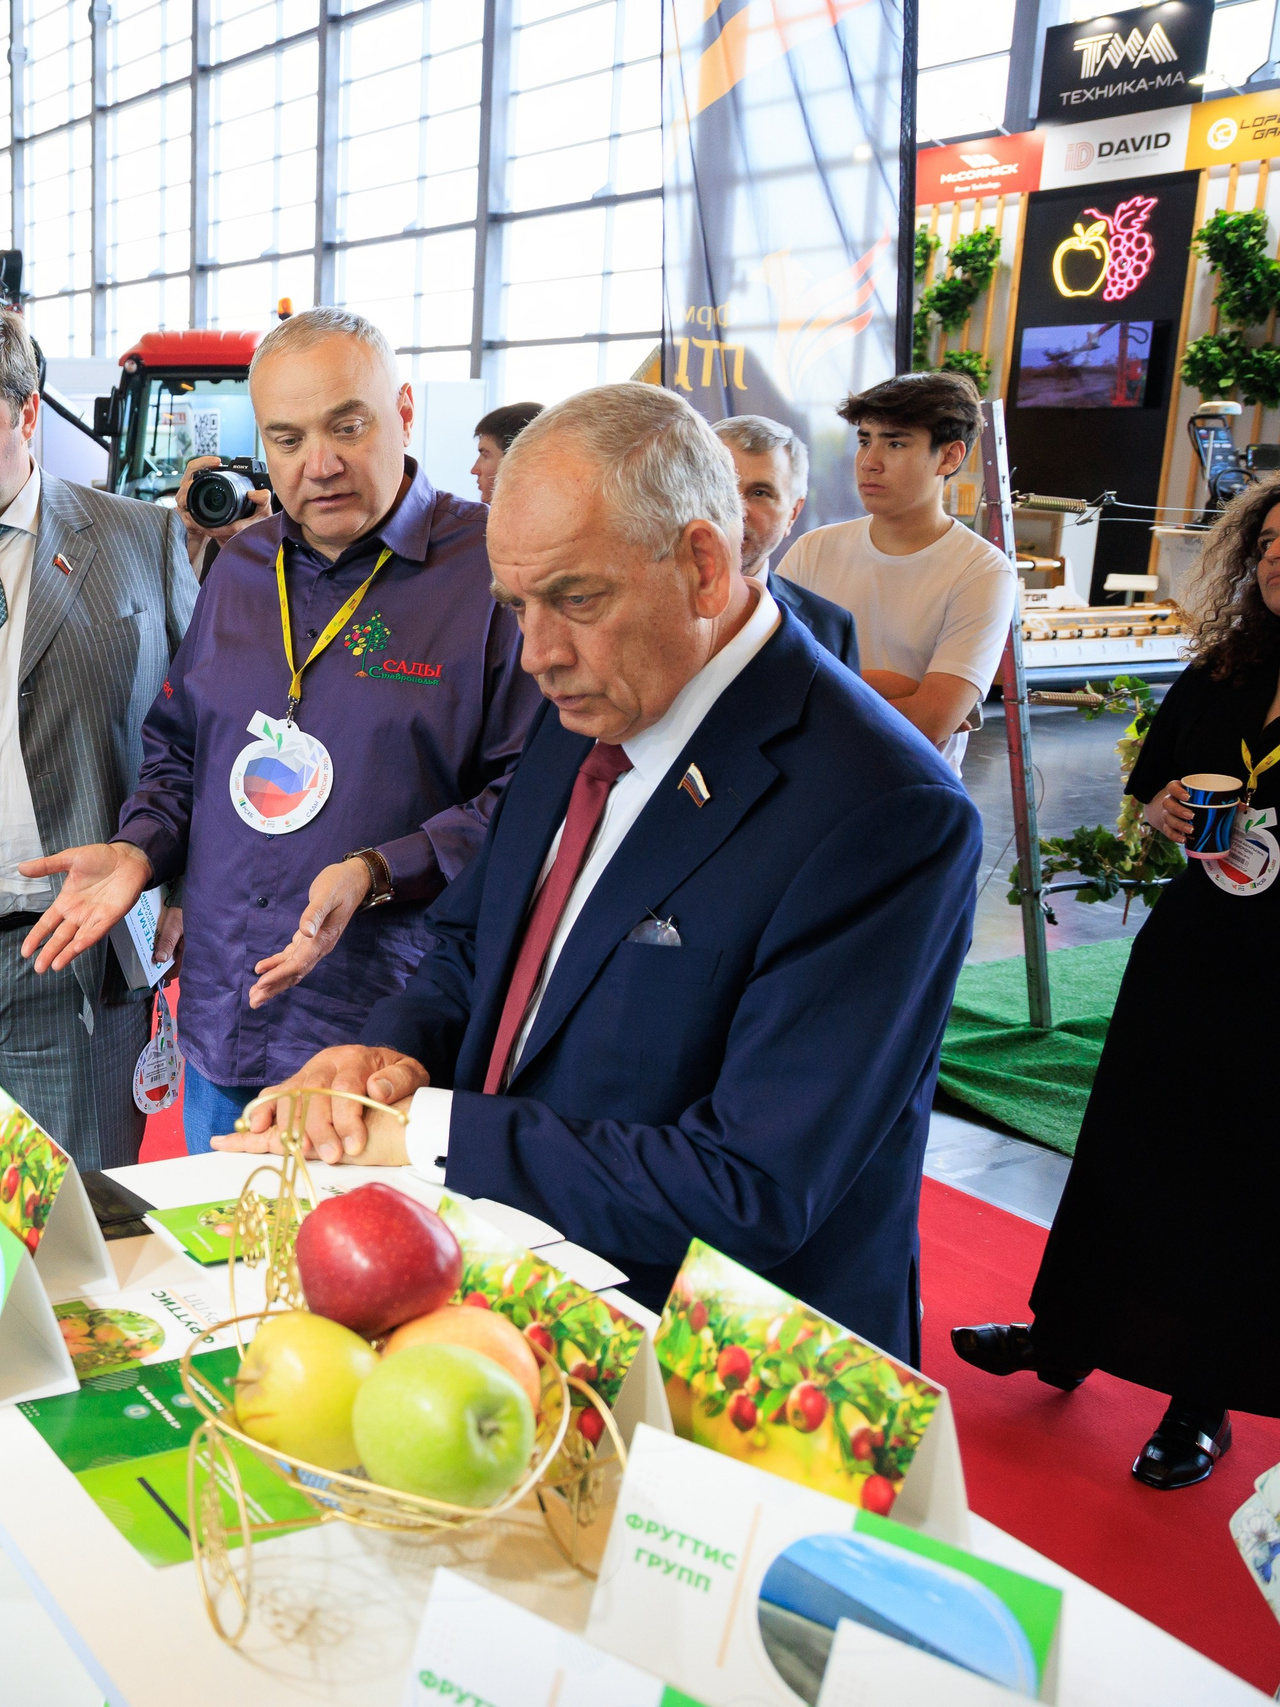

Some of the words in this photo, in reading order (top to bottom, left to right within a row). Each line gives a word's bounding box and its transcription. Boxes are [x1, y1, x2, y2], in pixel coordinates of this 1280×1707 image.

[1060, 70, 1186, 107] ТЕХНИКА-МА
[1238, 114, 1280, 131] LOP
[1252, 126, 1280, 141] GA
[1097, 132, 1172, 158] DAVID
[368, 665, 439, 686] Ставрополья
[382, 659, 444, 678] САДЫ
[306, 800, 320, 818] САДЫ
[317, 773, 328, 799] РОССИИ
[137, 908, 162, 969] ССТЕМА
[625, 1512, 738, 1572] ФРУТТИС
[634, 1546, 713, 1593] ГРУПП
